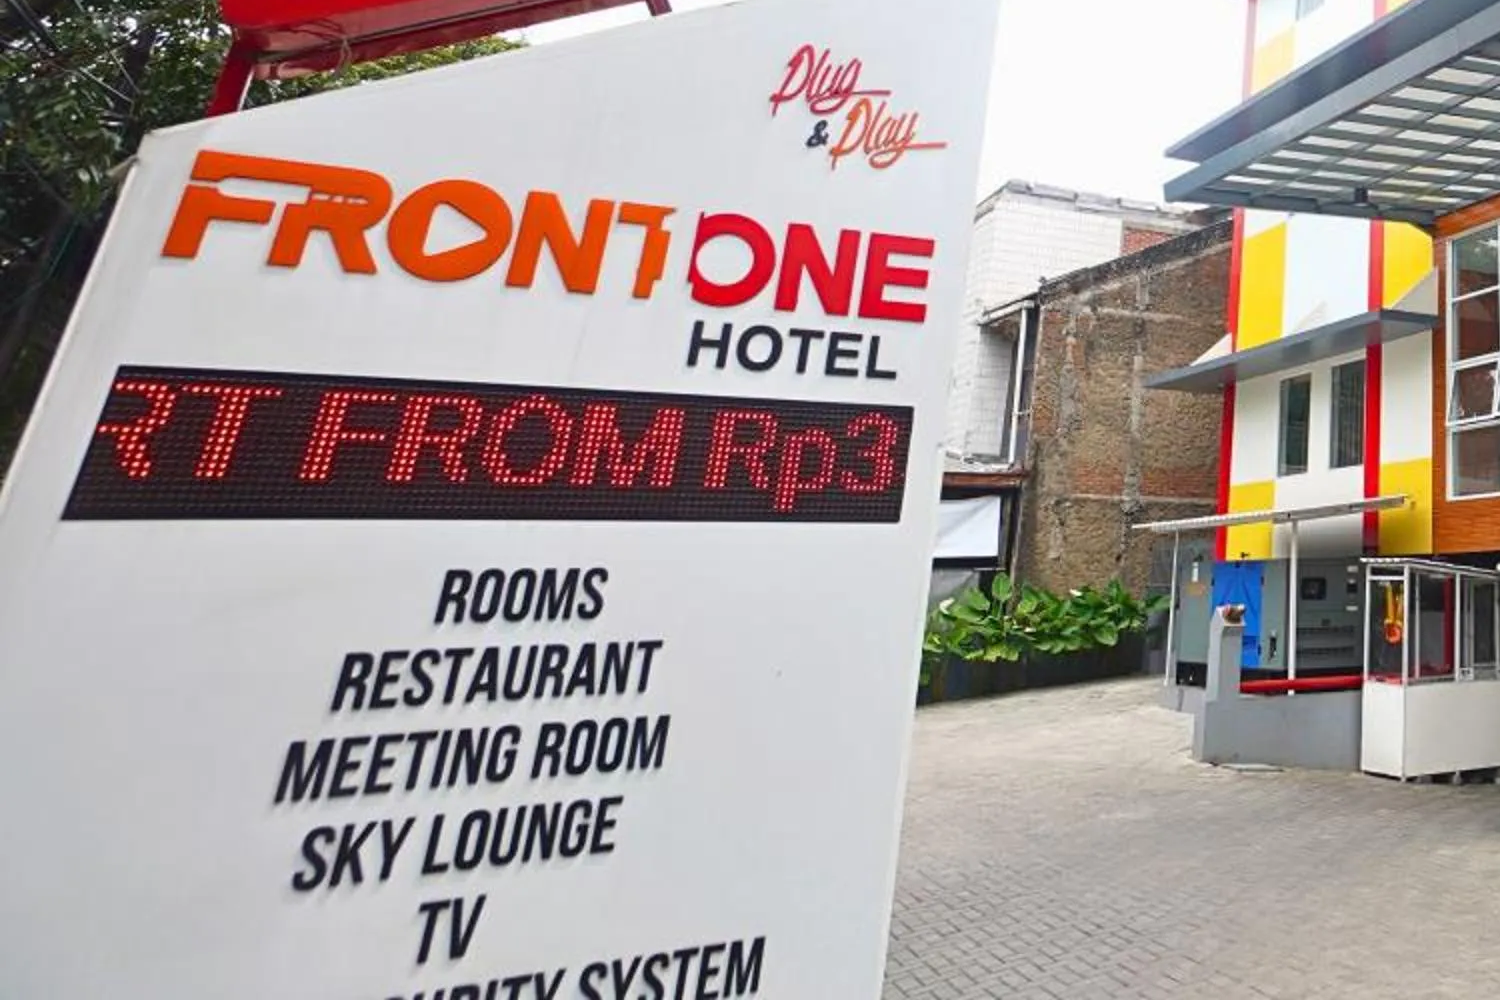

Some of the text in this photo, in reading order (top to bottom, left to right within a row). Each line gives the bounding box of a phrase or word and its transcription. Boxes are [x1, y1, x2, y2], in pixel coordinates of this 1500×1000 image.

[769, 44, 891, 117] Plug
[805, 98, 947, 170] & Play
[686, 320, 897, 380] HOTEL
[299, 389, 686, 488] FROM
[702, 408, 899, 513] Rp3
[434, 567, 609, 625] ROOMS
[331, 640, 663, 712] RESTAURANT
[273, 714, 671, 804] MEETING ROOM
[292, 796, 624, 892] SKY LOUNGE
[415, 894, 487, 965] TV
[578, 936, 766, 1000] SYSTEM
